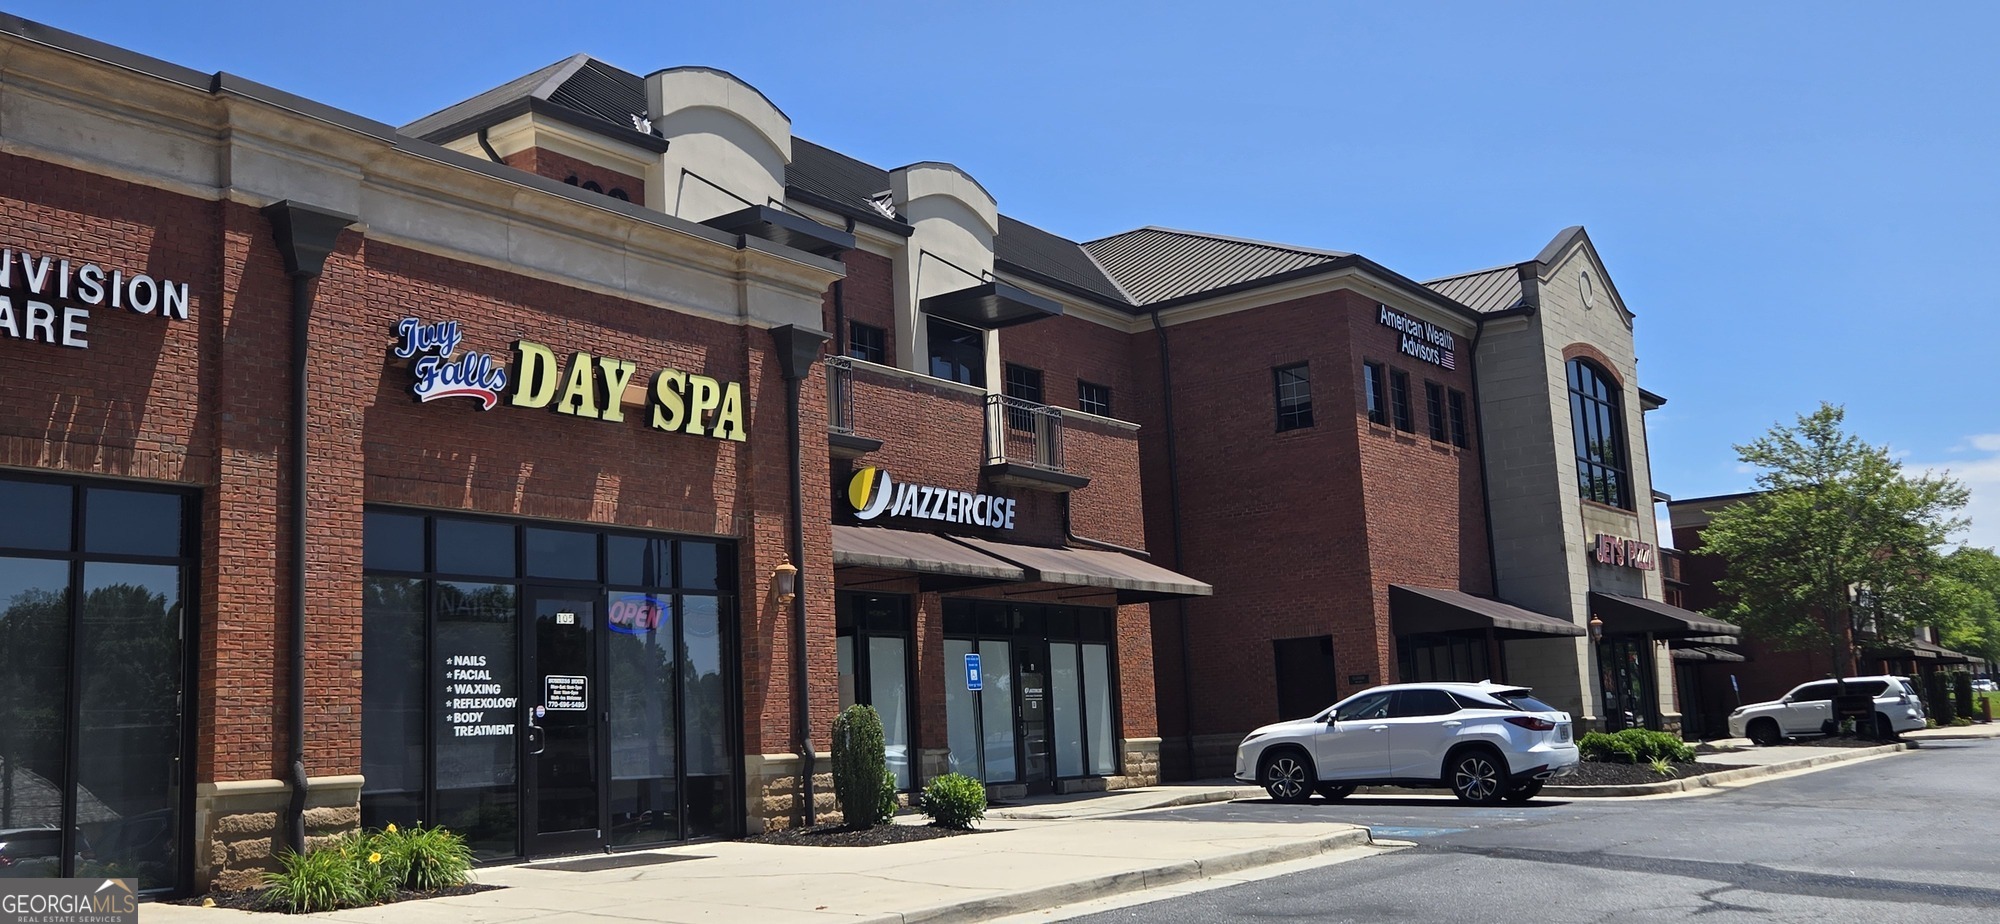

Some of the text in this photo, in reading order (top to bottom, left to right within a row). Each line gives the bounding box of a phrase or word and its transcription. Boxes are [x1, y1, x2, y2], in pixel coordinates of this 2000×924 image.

[394, 317, 462, 359] Ivy
[1380, 304, 1455, 351] American Wealth
[1401, 333, 1440, 366] Advisors
[413, 350, 507, 396] Falls
[511, 339, 747, 442] DAY SPA
[890, 482, 1016, 530] JAZZERCISE
[608, 600, 661, 629] OPEN
[453, 655, 487, 666] NAILS
[453, 669, 492, 681] FACIAL
[453, 697, 518, 709] REFLEXOLOGY
[454, 684, 502, 695] WAXING
[453, 712, 484, 723] BODY
[453, 724, 515, 737] TREATMENT
